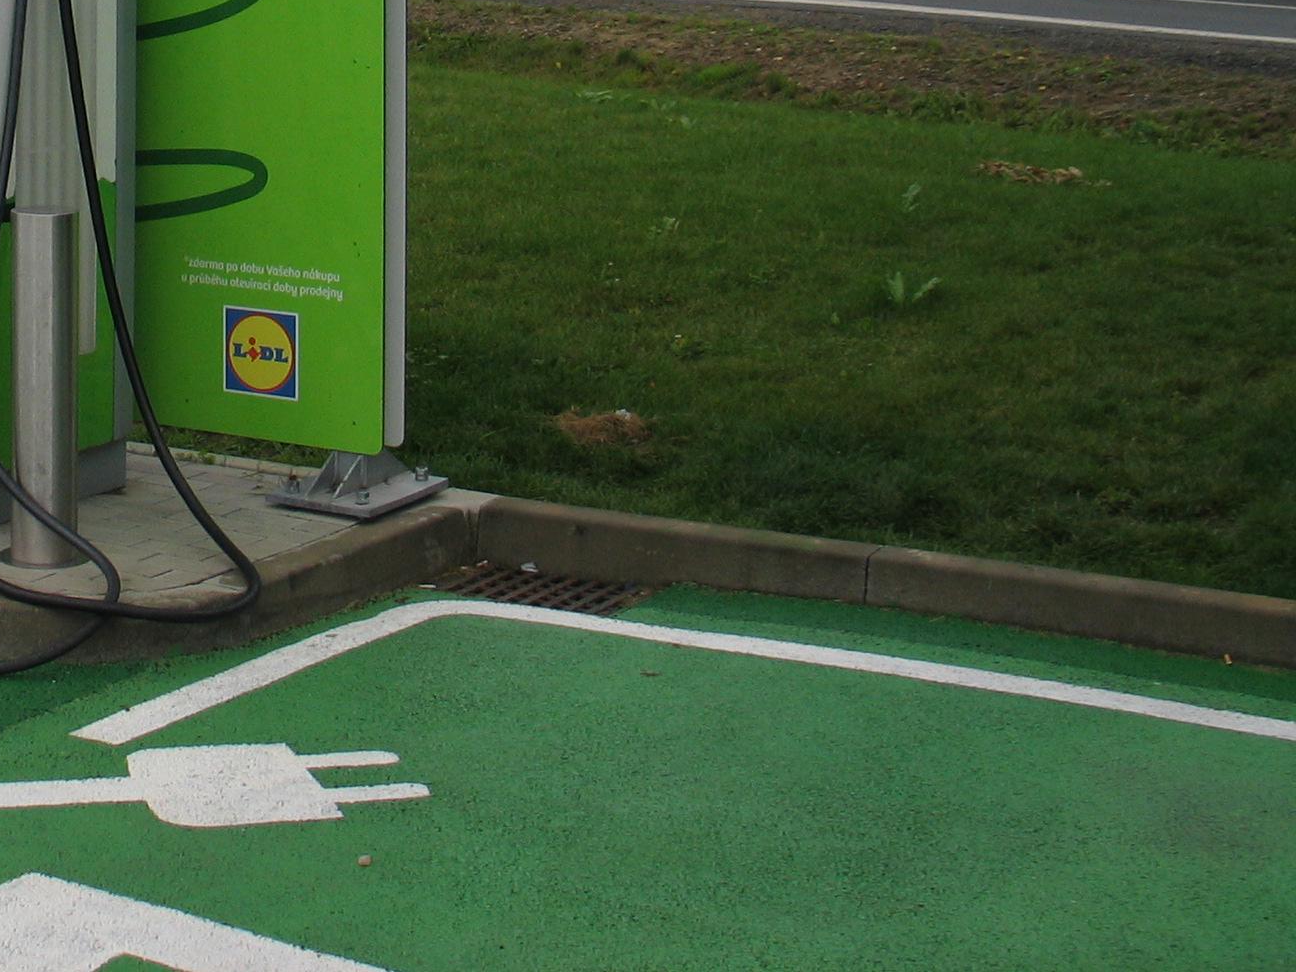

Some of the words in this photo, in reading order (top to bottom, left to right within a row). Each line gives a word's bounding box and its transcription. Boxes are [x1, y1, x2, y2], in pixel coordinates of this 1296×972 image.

[226, 262, 239, 273] po
[240, 262, 264, 274] dobu
[273, 281, 298, 297] doby
[299, 285, 343, 301] prodejny
[233, 337, 288, 363] LIDL
